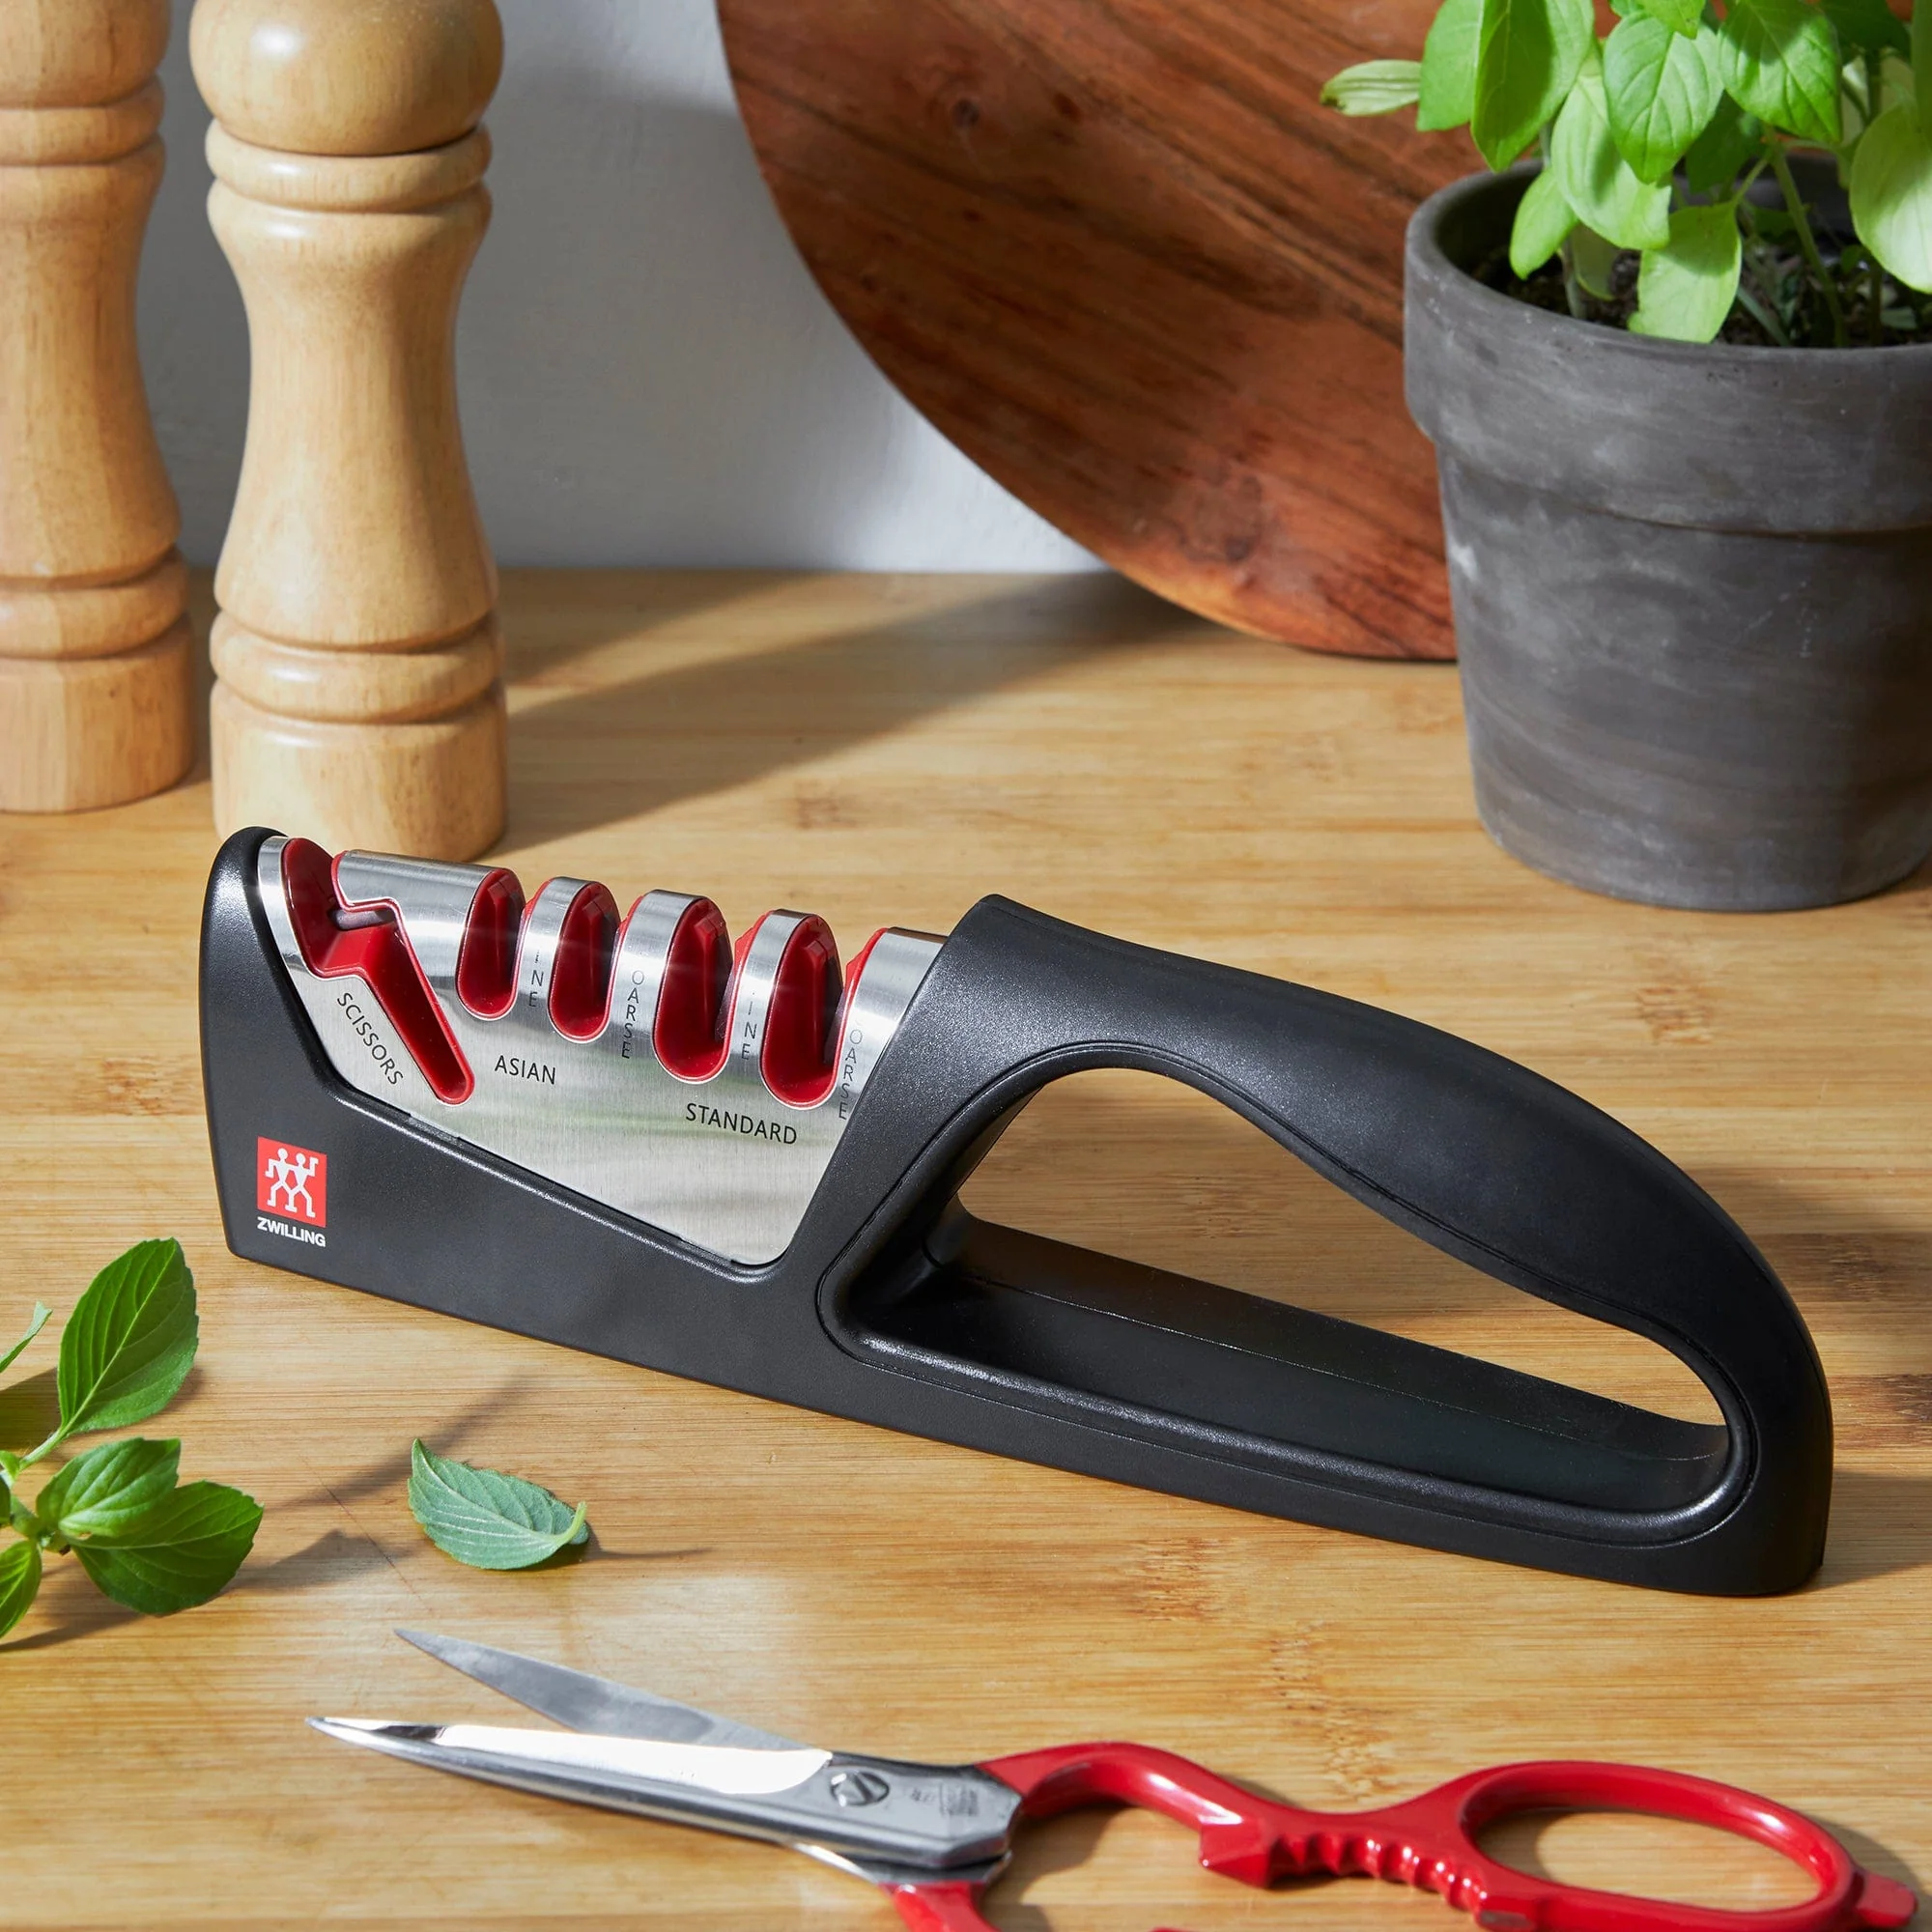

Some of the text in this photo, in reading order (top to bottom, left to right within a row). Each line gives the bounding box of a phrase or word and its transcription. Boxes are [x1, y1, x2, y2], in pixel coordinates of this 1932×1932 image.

[528, 950, 545, 1008] INE
[337, 992, 404, 1086] SCISSORS
[621, 969, 644, 1060] OARSE
[741, 992, 757, 1061] INE
[494, 1054, 556, 1085] ASIAN
[838, 1021, 864, 1121] OARSE
[685, 1102, 798, 1146] STANDARD
[256, 1216, 327, 1248] ZWILLING
